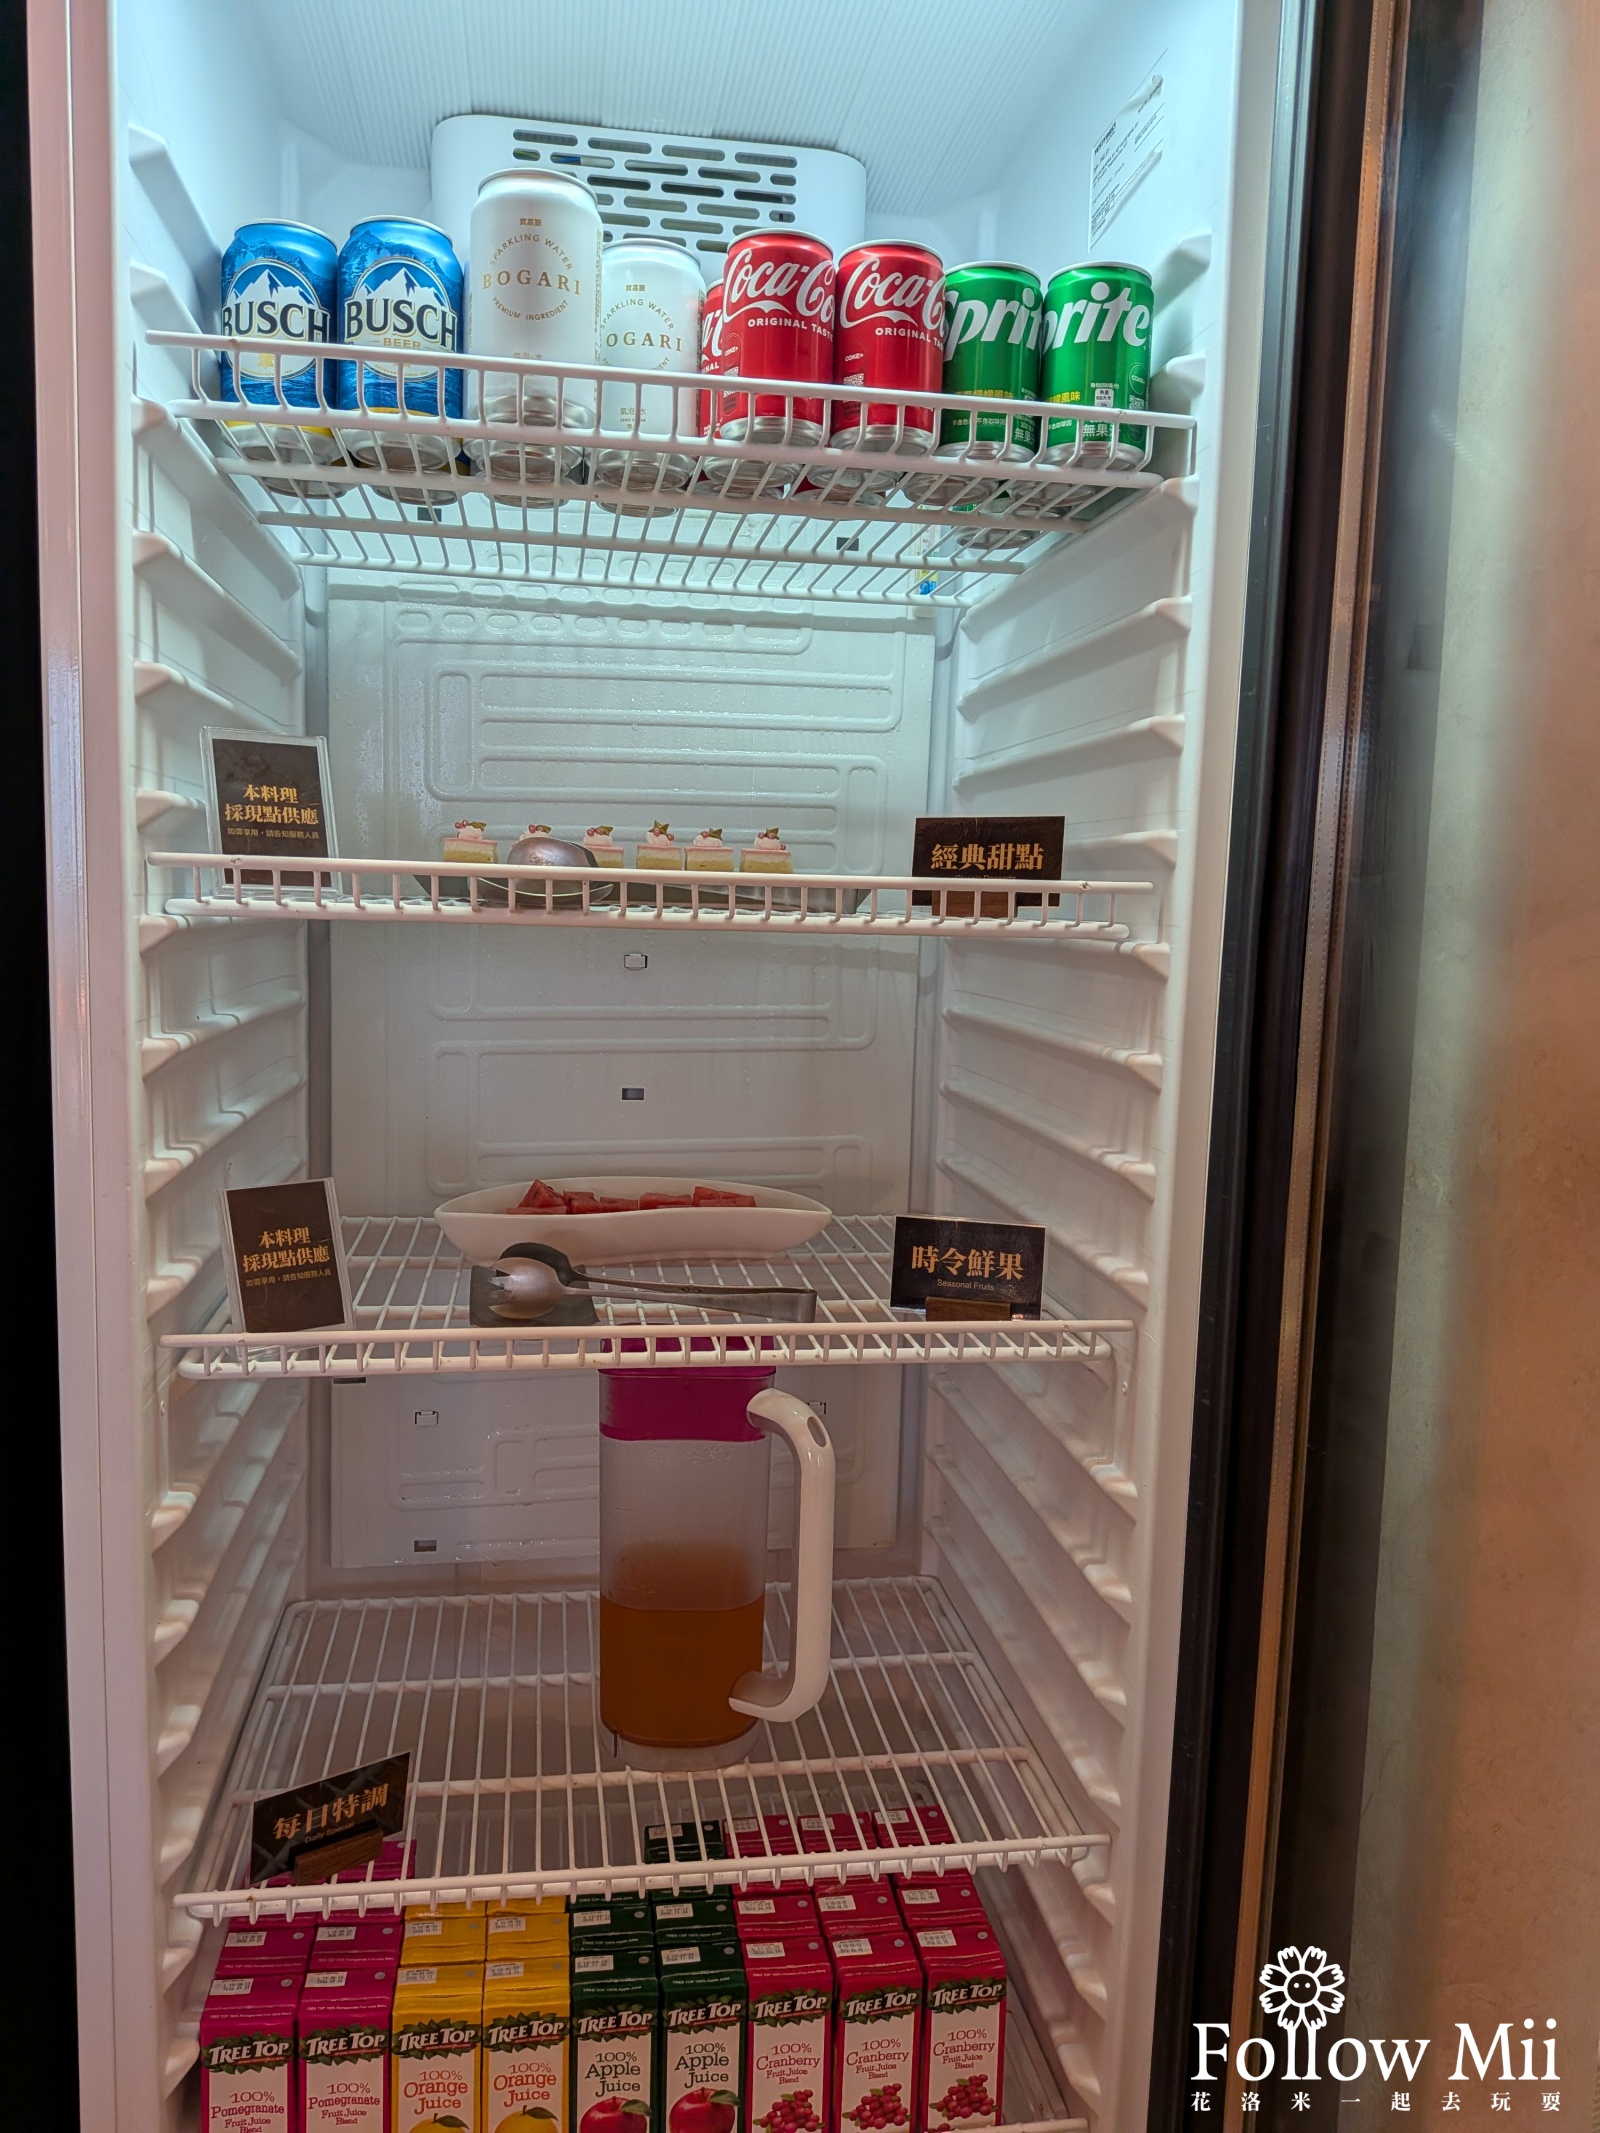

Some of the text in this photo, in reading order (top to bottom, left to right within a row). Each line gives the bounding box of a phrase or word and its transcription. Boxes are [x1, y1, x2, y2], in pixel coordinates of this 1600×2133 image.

[489, 233, 573, 271] SPARKLING WATER
[482, 269, 581, 296] BOGARI
[723, 248, 835, 331] Coca-Co
[839, 257, 947, 338] Coca-C
[492, 296, 569, 321] PREMIUM INGREDIENT
[600, 298, 675, 330] SPARKLING WATER
[222, 300, 330, 343] BUSCH
[345, 298, 457, 350] BUSCH
[747, 317, 808, 330] ORIGINAL
[382, 337, 421, 350] BEER
[606, 331, 682, 352] OGARI
[875, 327, 945, 351] ORIGINAL TAS
[242, 784, 299, 804] 本料理
[224, 803, 320, 826] 採現點供應
[930, 842, 1045, 871] 經典甜點
[257, 1226, 311, 1249] 本料理
[242, 1245, 331, 1274] 採現點供應
[911, 1245, 1024, 1281] 時令鮮果
[937, 1278, 995, 1292] Seasonal Fruits
[272, 1782, 389, 1840] 每日特調
[304, 1820, 355, 1844] Daily Special
[845, 1997, 883, 2018] TREE
[884, 1991, 917, 2009] TOP
[932, 1983, 1003, 2007] TREE TOP
[667, 2002, 742, 2028] TREE TOP
[754, 1994, 828, 2019] TREE TOP
[487, 2019, 565, 2045] TREE TOP
[577, 2015, 617, 2035] TREE
[617, 2010, 653, 2028] TOP
[305, 2036, 348, 2057] TREE
[348, 2031, 386, 2050] TOP
[397, 2027, 476, 2051] TREE TOP
[861, 2037, 901, 2051] 100%
[947, 2028, 987, 2042] 100%
[208, 2040, 290, 2067] TREE TOP
[594, 2051, 638, 2063] 100%
[684, 2042, 726, 2055] 100%
[770, 2042, 812, 2056] 100%
[845, 2050, 910, 2066] Cranberry
[933, 2041, 996, 2057] Cranberry
[508, 2062, 552, 2075] 100%
[673, 2052, 730, 2072] Apple
[756, 2055, 821, 2071] Cranberry
[855, 2062, 897, 2074] Fruit Juice
[942, 2053, 983, 2065] Fruit Juice
[954, 2062, 975, 2070] Blend
[419, 2069, 463, 2082] 100%
[584, 2061, 641, 2080] Apple
[683, 2070, 729, 2089] Juice
[766, 2067, 808, 2079] Fruit Juice
[868, 2071, 889, 2080] Blend
[326, 2082, 371, 2095] 100%
[403, 2081, 469, 2099] Orange
[493, 2073, 557, 2091] Orange
[594, 2079, 641, 2098] Juice
[778, 2076, 800, 2085] Blend
[229, 2091, 275, 2104] 100%
[307, 2095, 381, 2110] Pomegranate
[413, 2096, 462, 2116] Juice
[503, 2088, 551, 2108] Juice
[210, 2103, 285, 2119] Pomegranate
[320, 2107, 367, 2119] Fruit Juice
[224, 2116, 272, 2129] Fruit Juice
[335, 2116, 358, 2126] Blend
